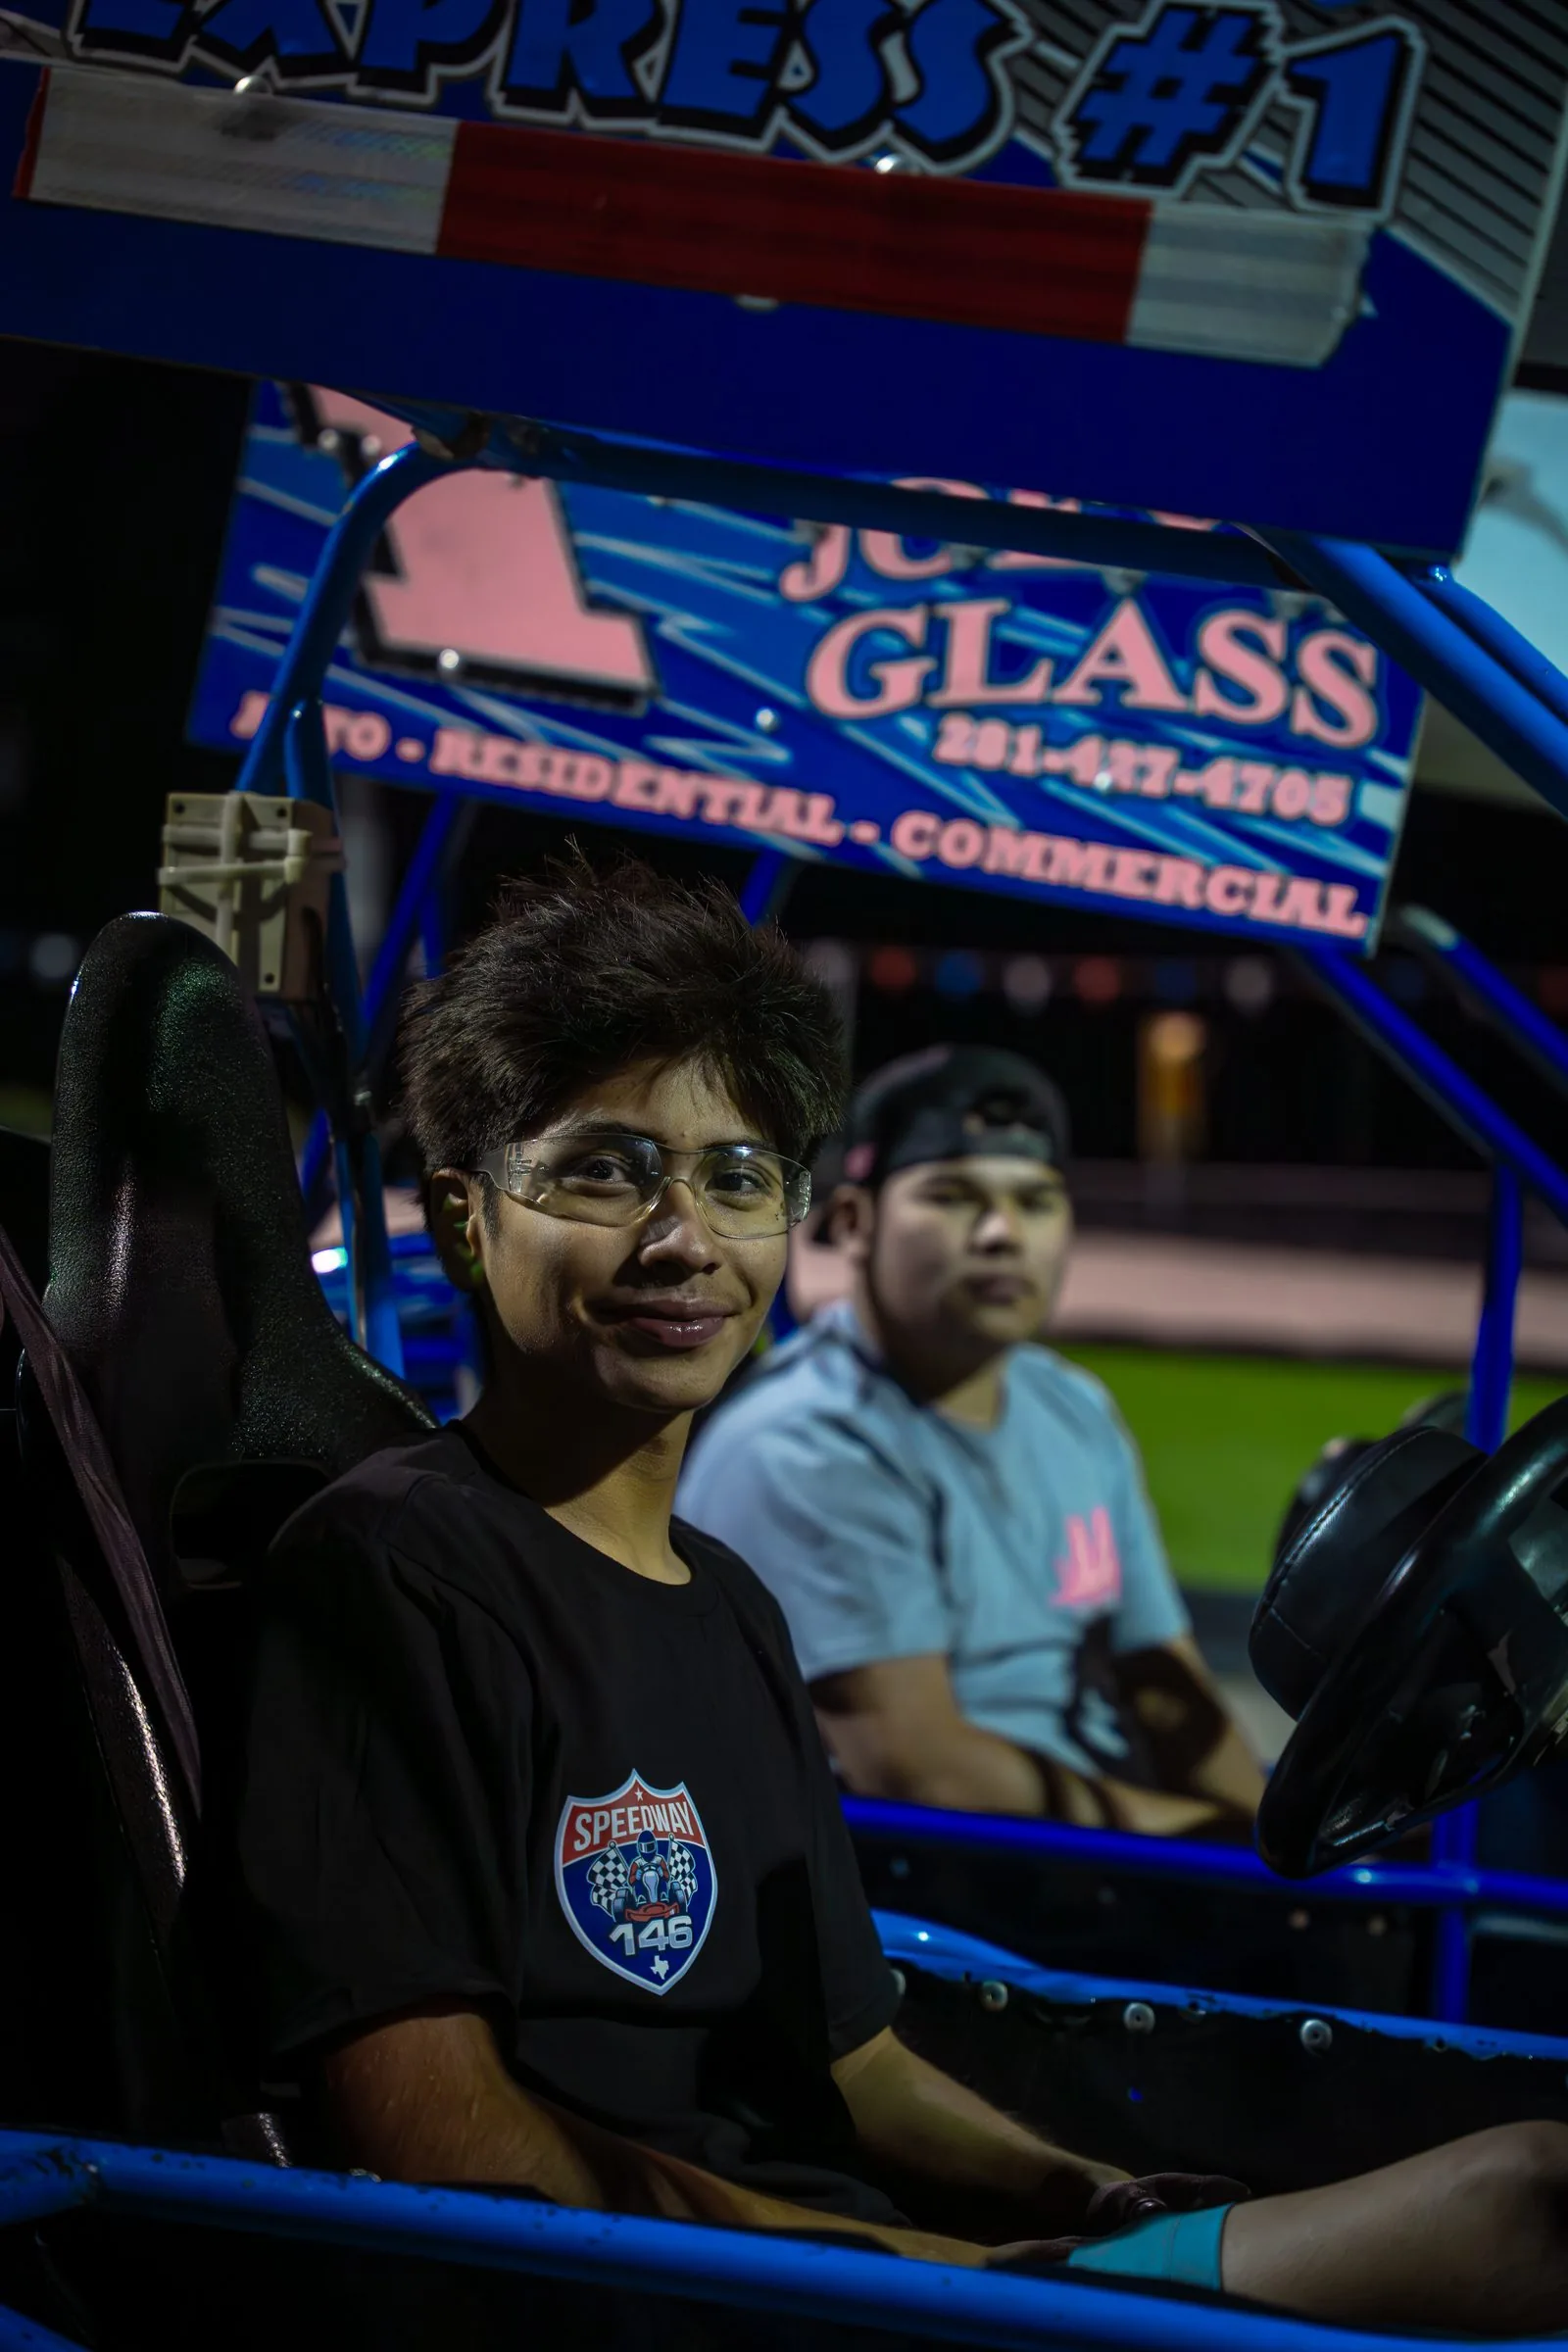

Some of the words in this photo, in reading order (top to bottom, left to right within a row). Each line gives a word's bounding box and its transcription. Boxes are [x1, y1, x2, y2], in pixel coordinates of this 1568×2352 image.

[65, 0, 1027, 169] RESS
[1062, 4, 1411, 208] #1
[806, 598, 1378, 747] GLASS
[429, 727, 845, 847] RESIDENTIAL
[890, 809, 1368, 939] COMMERCIAL
[934, 712, 1350, 826] 281-427-4705
[573, 1801, 695, 1851] SPEEDWAY
[609, 1915, 693, 1956] 146
